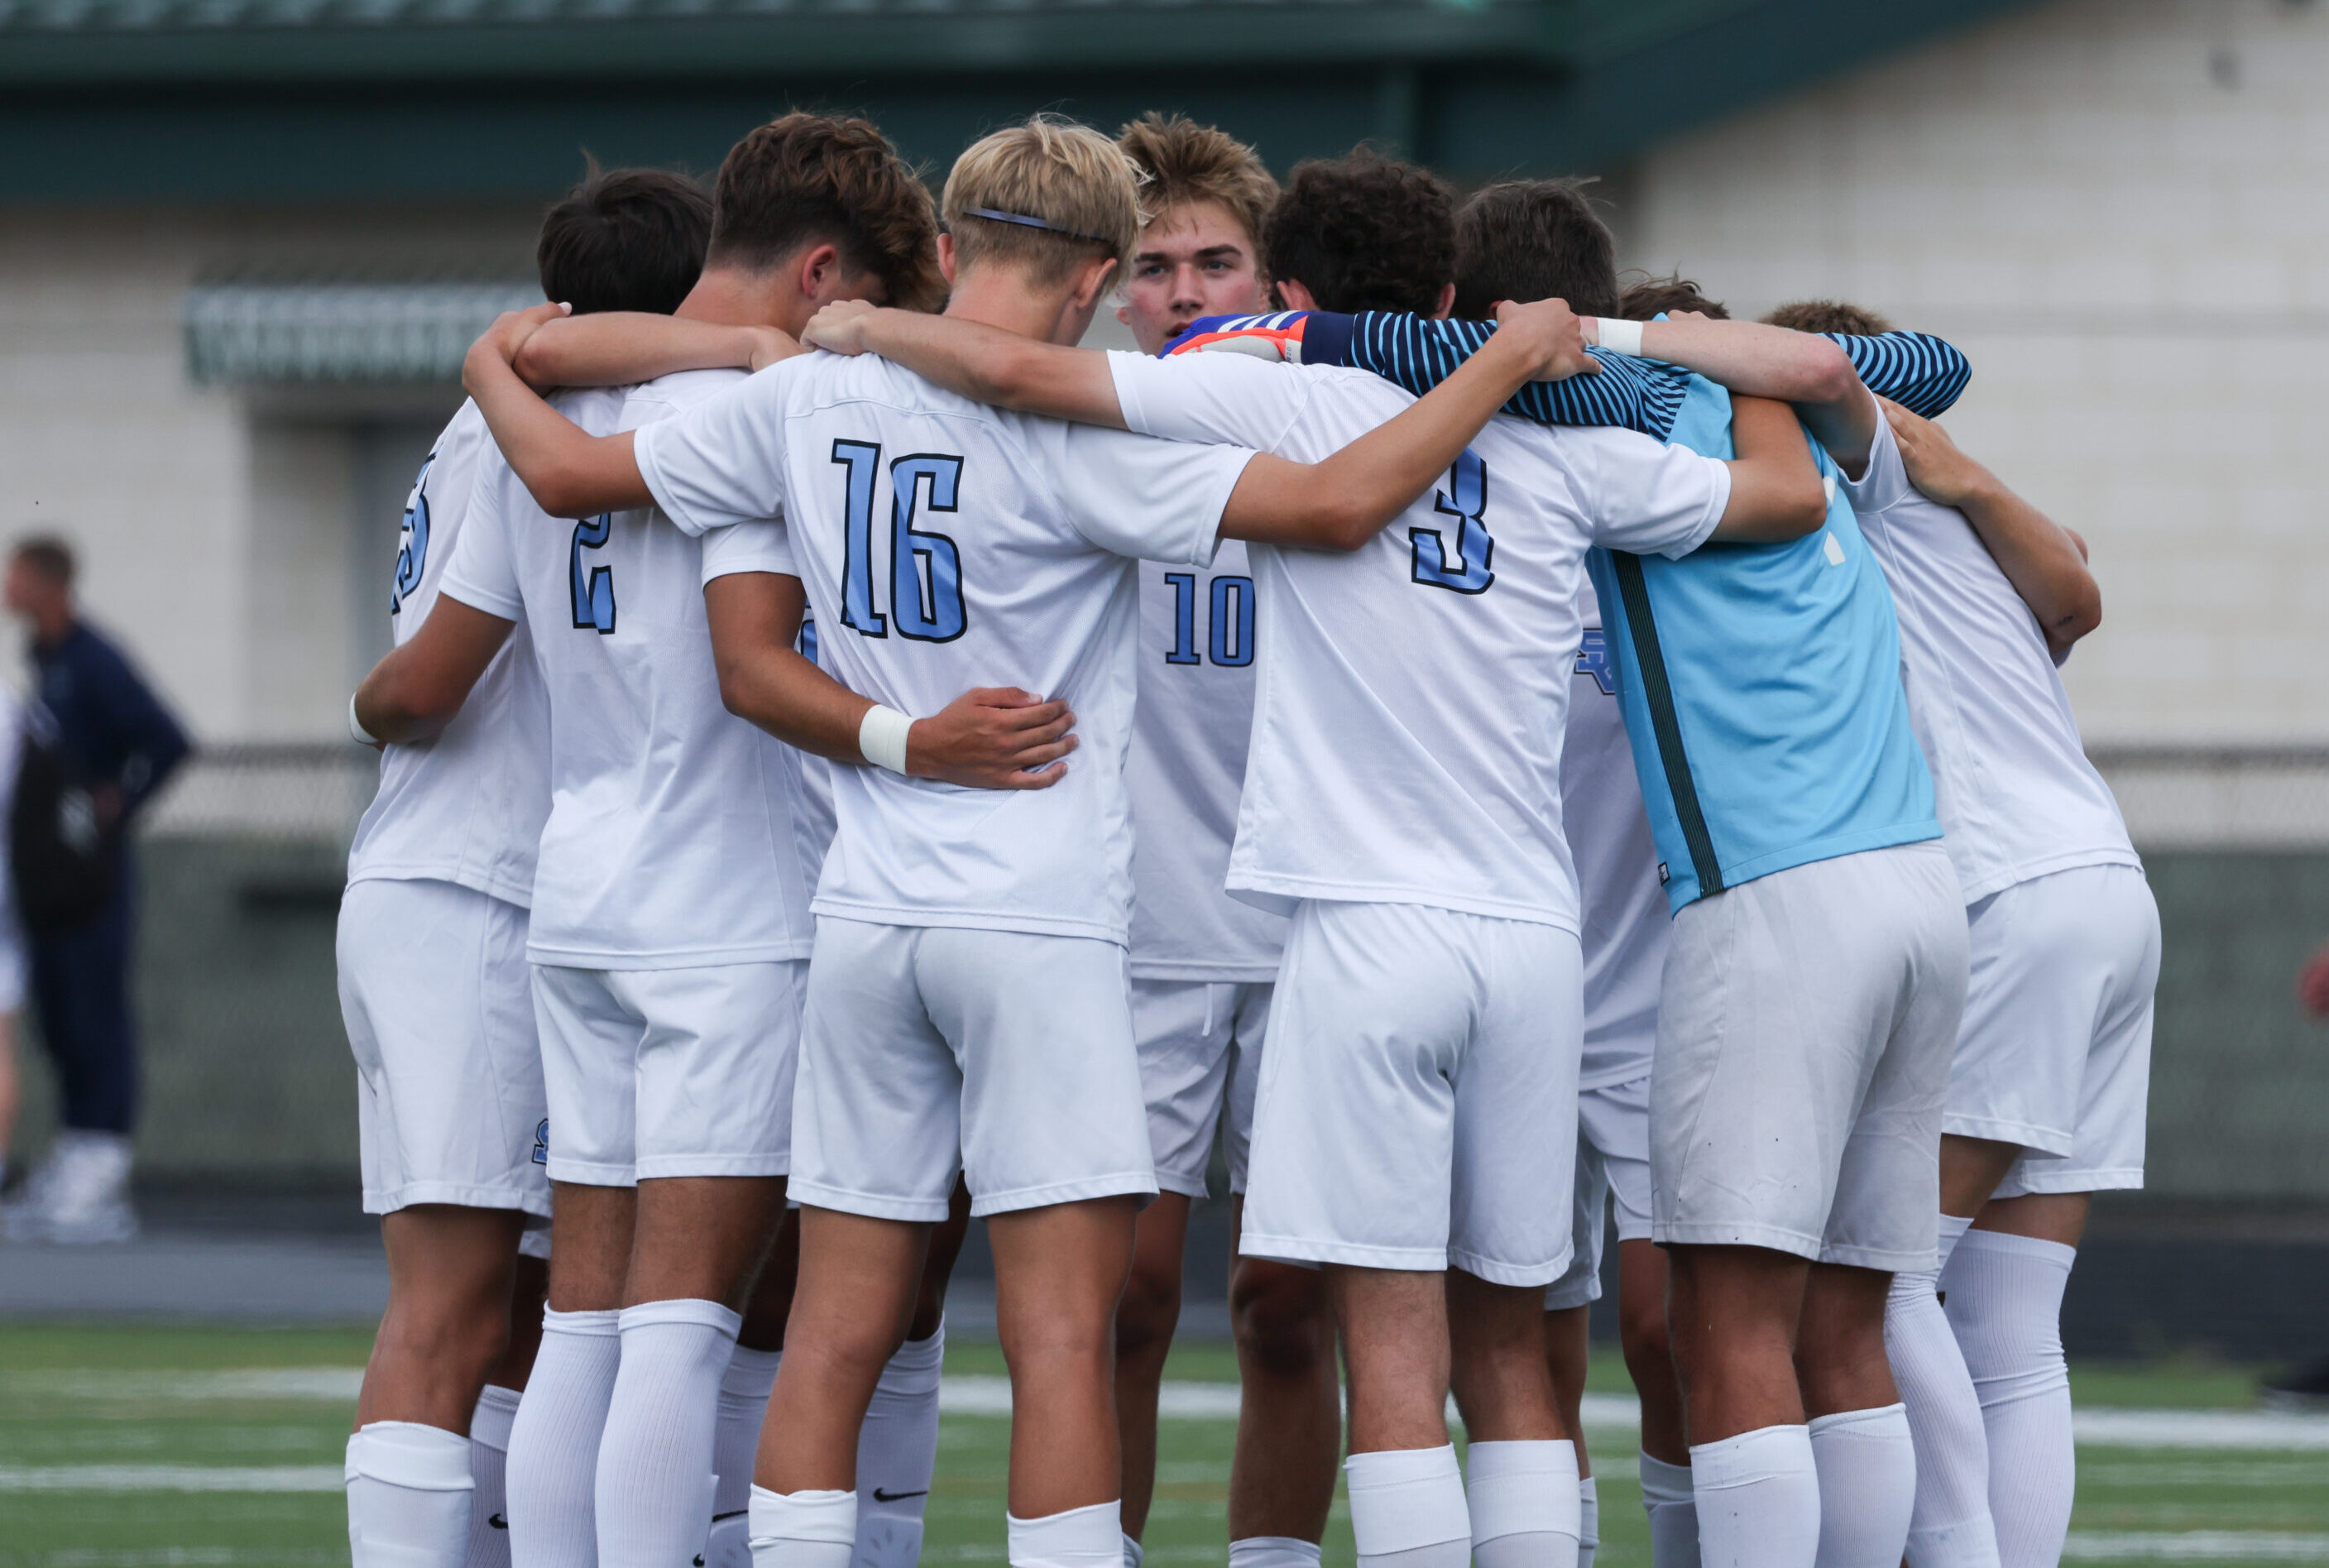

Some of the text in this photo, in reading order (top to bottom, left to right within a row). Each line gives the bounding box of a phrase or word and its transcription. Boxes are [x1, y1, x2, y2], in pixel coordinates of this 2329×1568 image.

[569, 512, 616, 635] 2
[831, 438, 967, 644] 16
[1408, 447, 1495, 595] 3
[1165, 572, 1255, 667] 10
